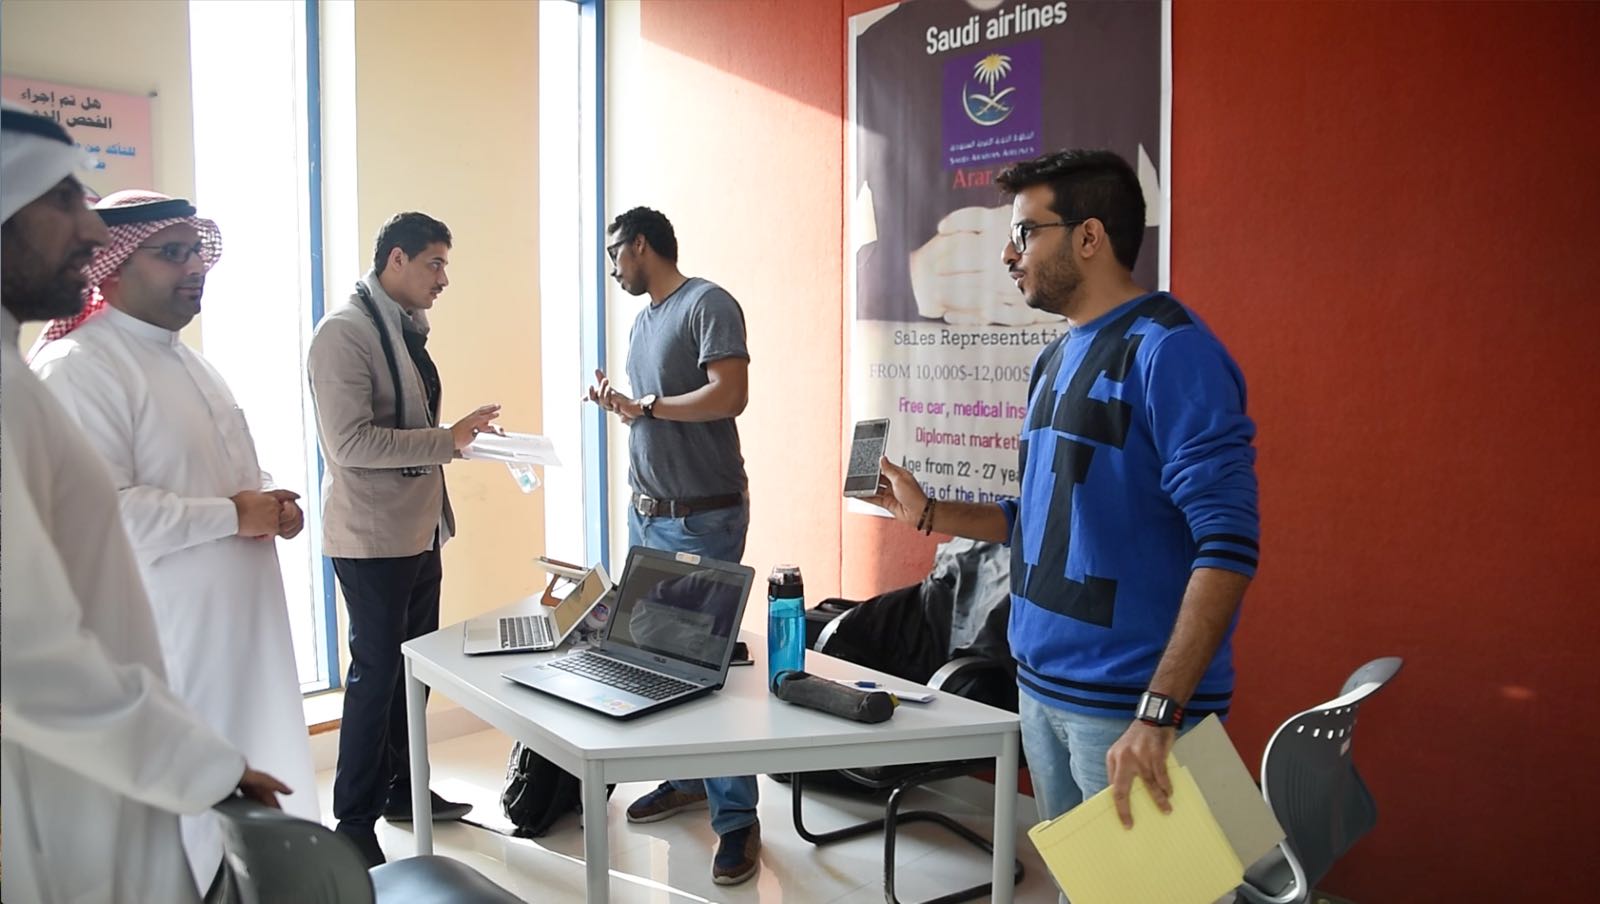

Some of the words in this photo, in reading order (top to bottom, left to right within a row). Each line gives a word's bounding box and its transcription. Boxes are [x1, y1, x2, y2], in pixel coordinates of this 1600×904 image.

[926, 16, 980, 55] Saudi
[985, 1, 1068, 40] airlines
[59, 95, 76, 108] تم
[81, 96, 102, 111] هل
[66, 114, 113, 129] الفحص
[894, 330, 936, 346] Sales
[941, 329, 1067, 349] Representati
[869, 363, 911, 379] FROM
[899, 397, 924, 413] Free
[953, 400, 1003, 417] medical
[915, 426, 966, 448] Diplomat
[902, 455, 922, 474] Age
[925, 457, 954, 476] from
[957, 460, 971, 478] 22
[982, 463, 997, 480] 27
[938, 484, 951, 500] of
[955, 485, 975, 501] the
